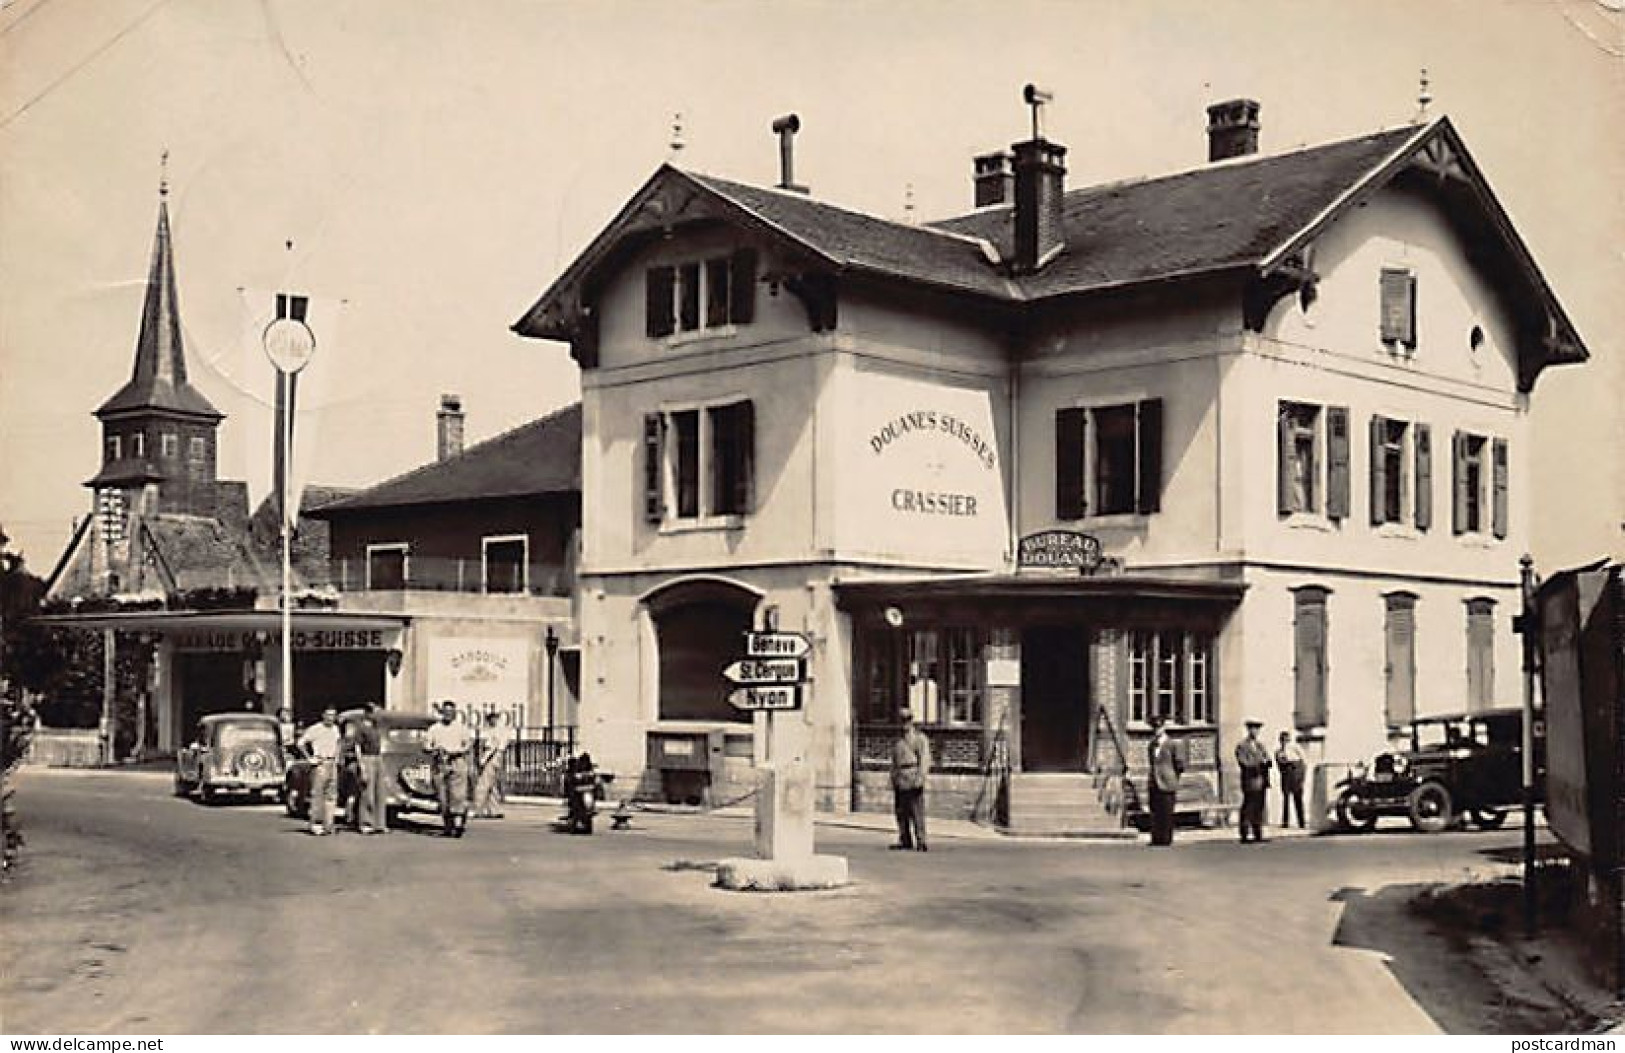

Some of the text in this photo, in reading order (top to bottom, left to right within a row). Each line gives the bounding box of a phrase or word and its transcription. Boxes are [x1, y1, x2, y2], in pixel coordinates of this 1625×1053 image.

[870, 411, 996, 469] DOUANES SUISSES
[891, 488, 977, 516] CRASSIER
[1022, 533, 1096, 550] BUREAU
[1022, 553, 1096, 566] DOUANE
[746, 688, 788, 707] Nyon
